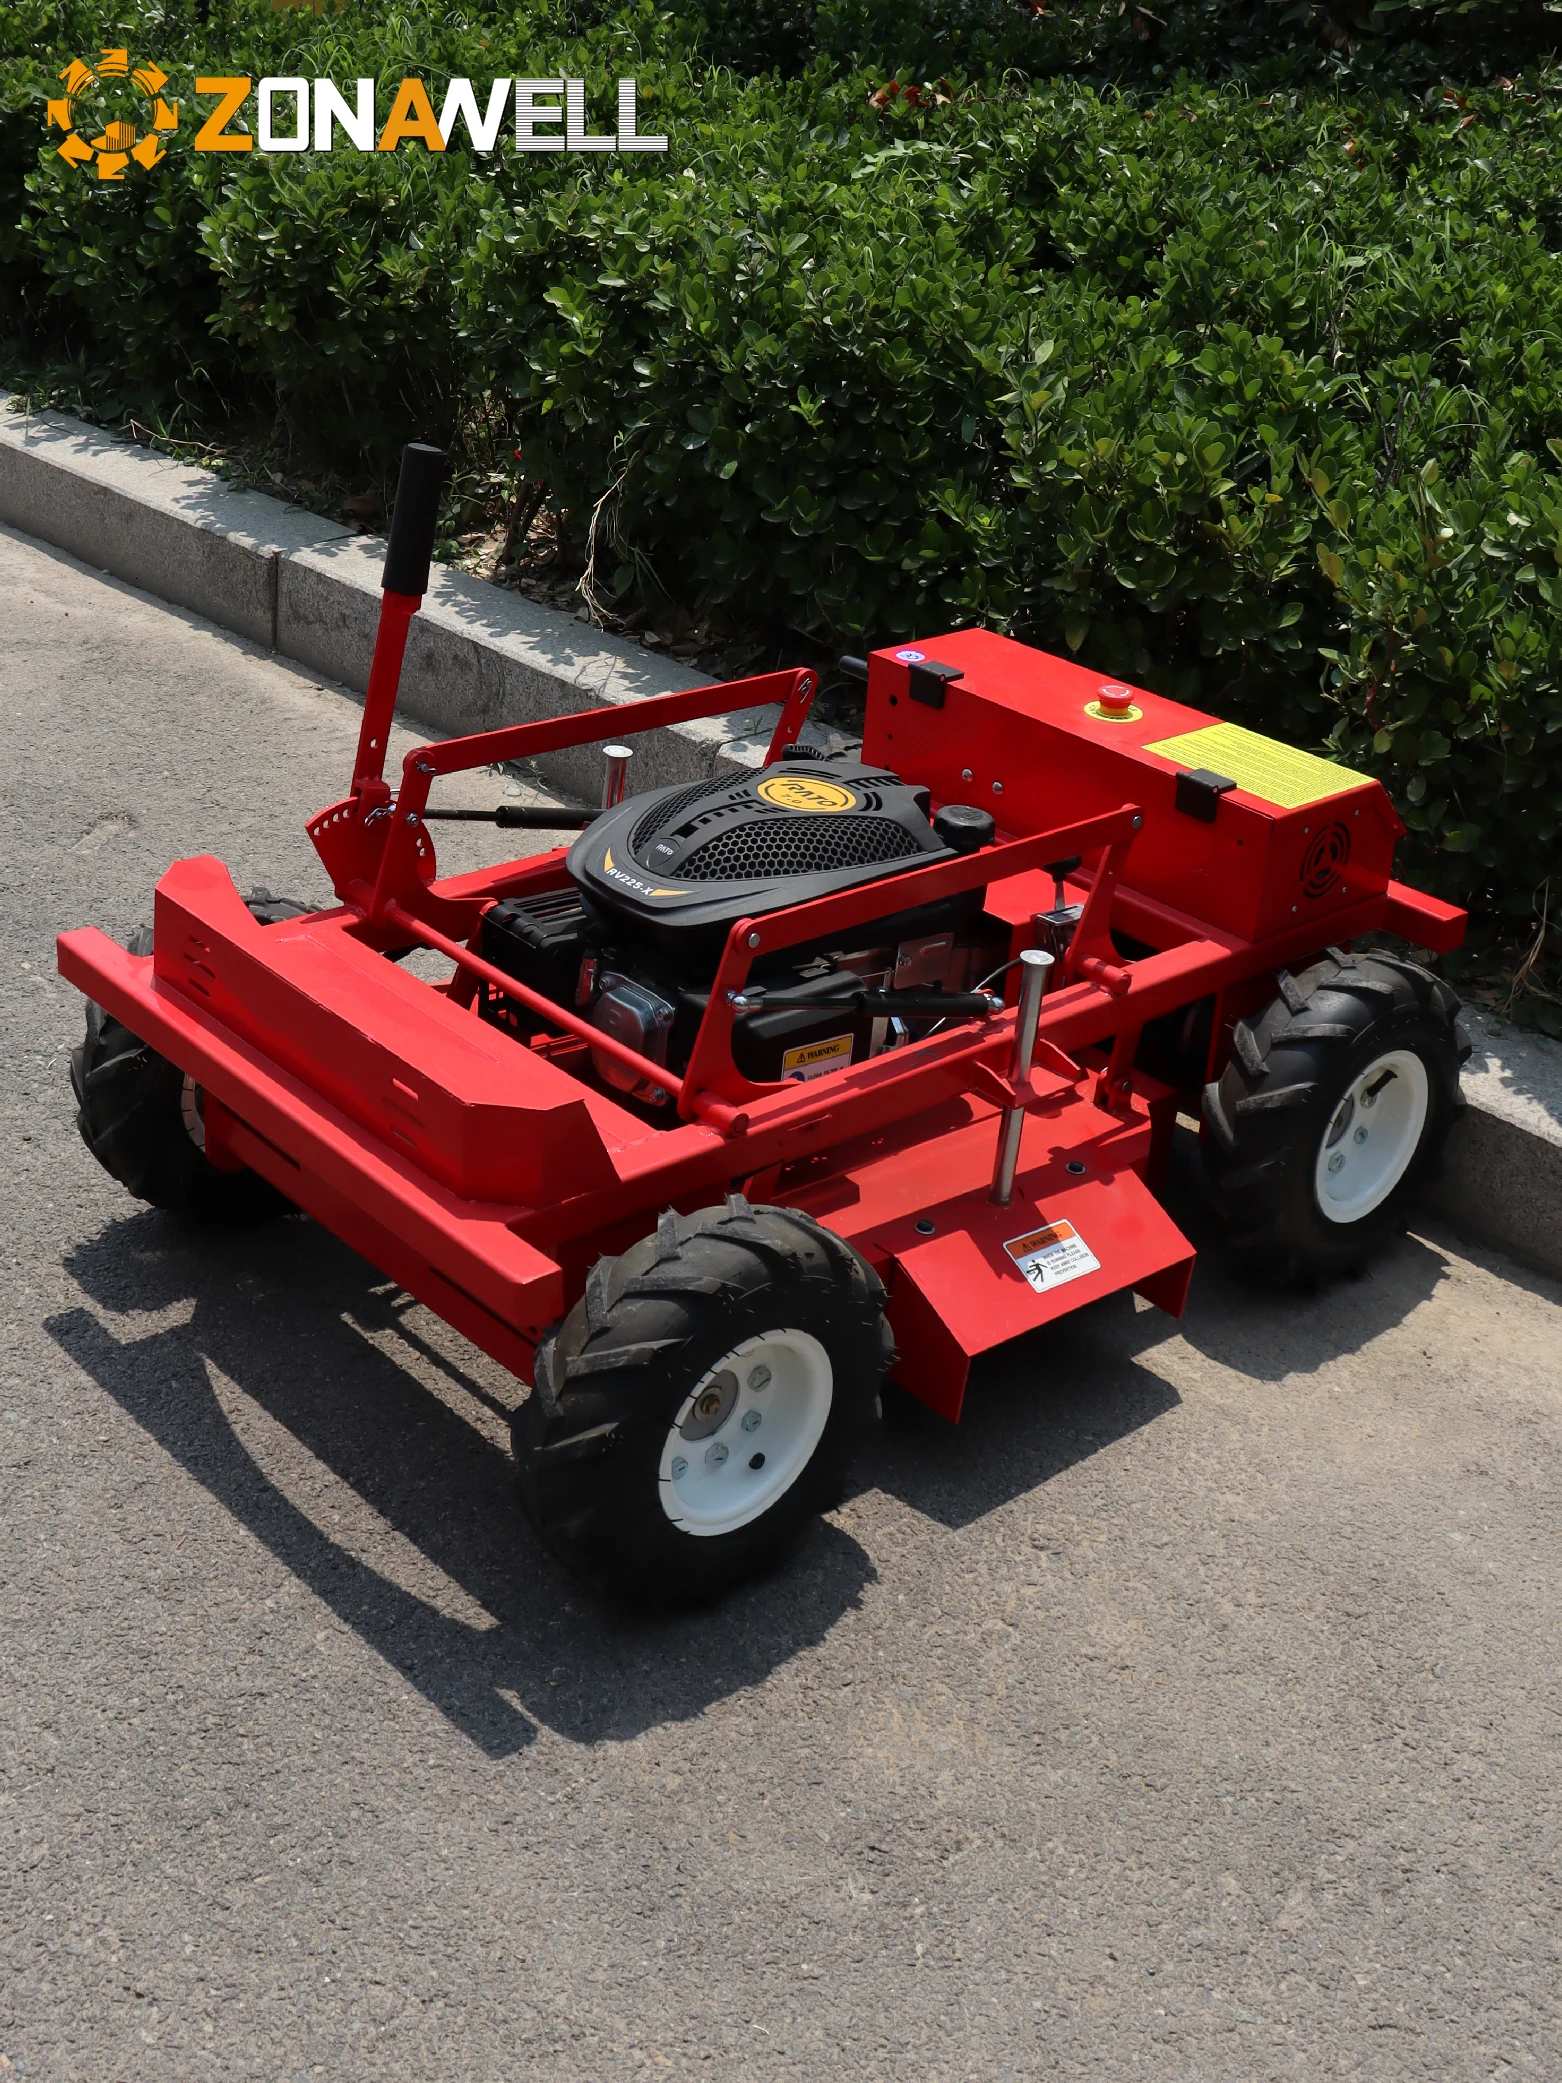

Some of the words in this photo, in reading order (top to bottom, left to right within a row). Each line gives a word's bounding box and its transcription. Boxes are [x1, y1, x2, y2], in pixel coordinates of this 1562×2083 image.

[780, 783, 838, 807] RATO
[655, 843, 674, 856] RATO
[606, 867, 654, 895] RV225-X
[807, 1044, 840, 1059] WARNING
[1030, 1231, 1063, 1248] WARNING
